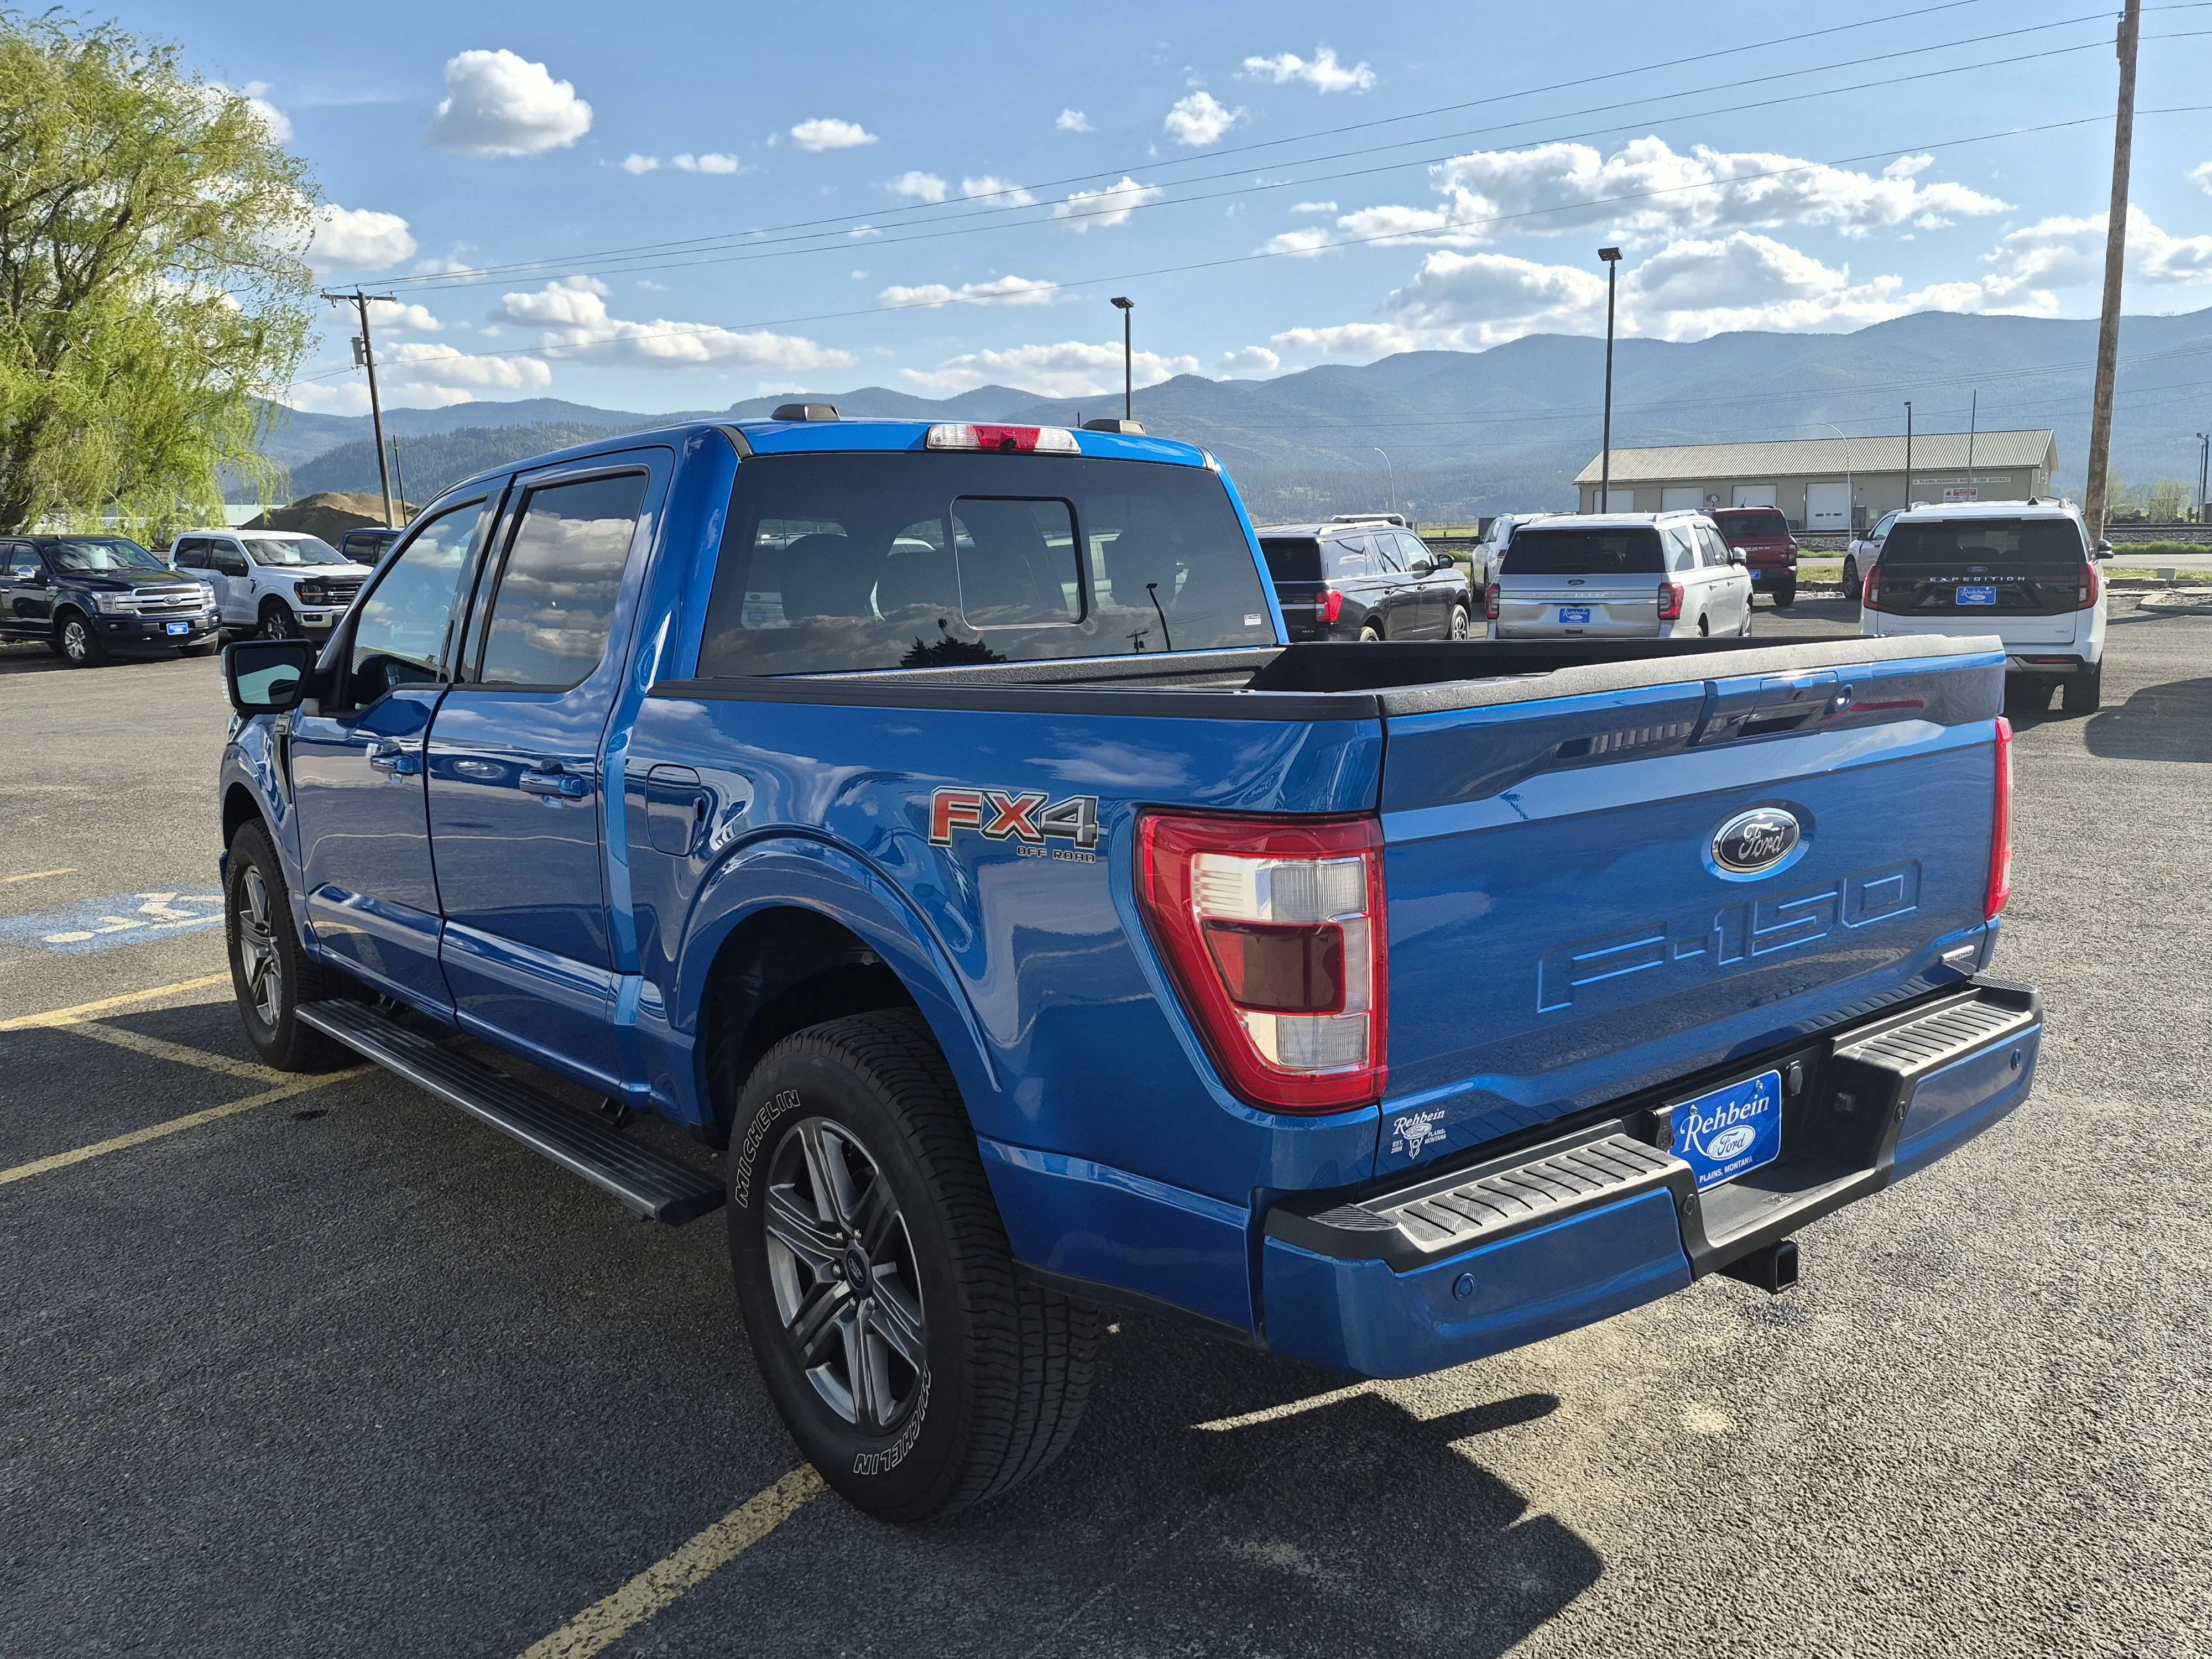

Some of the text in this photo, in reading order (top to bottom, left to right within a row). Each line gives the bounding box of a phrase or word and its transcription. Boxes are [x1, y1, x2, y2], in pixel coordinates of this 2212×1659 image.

[1960, 587, 1992, 599] Rehbein
[928, 785, 1099, 851] FX4
[1016, 846, 1095, 864] OFF ROAD
[1738, 821, 1785, 859] Ford
[1537, 859, 1921, 1014] F-150
[1393, 1108, 1445, 1136] Rehbein
[1679, 1094, 1770, 1157] Rehbein
[734, 1089, 802, 1209] MICHELIN
[1425, 1134, 1447, 1145] MONTANA
[1717, 1132, 1746, 1156] Ford
[1699, 1155, 1753, 1184] PLAINS, MONTANA
[852, 1360, 933, 1476] MICHELIN
